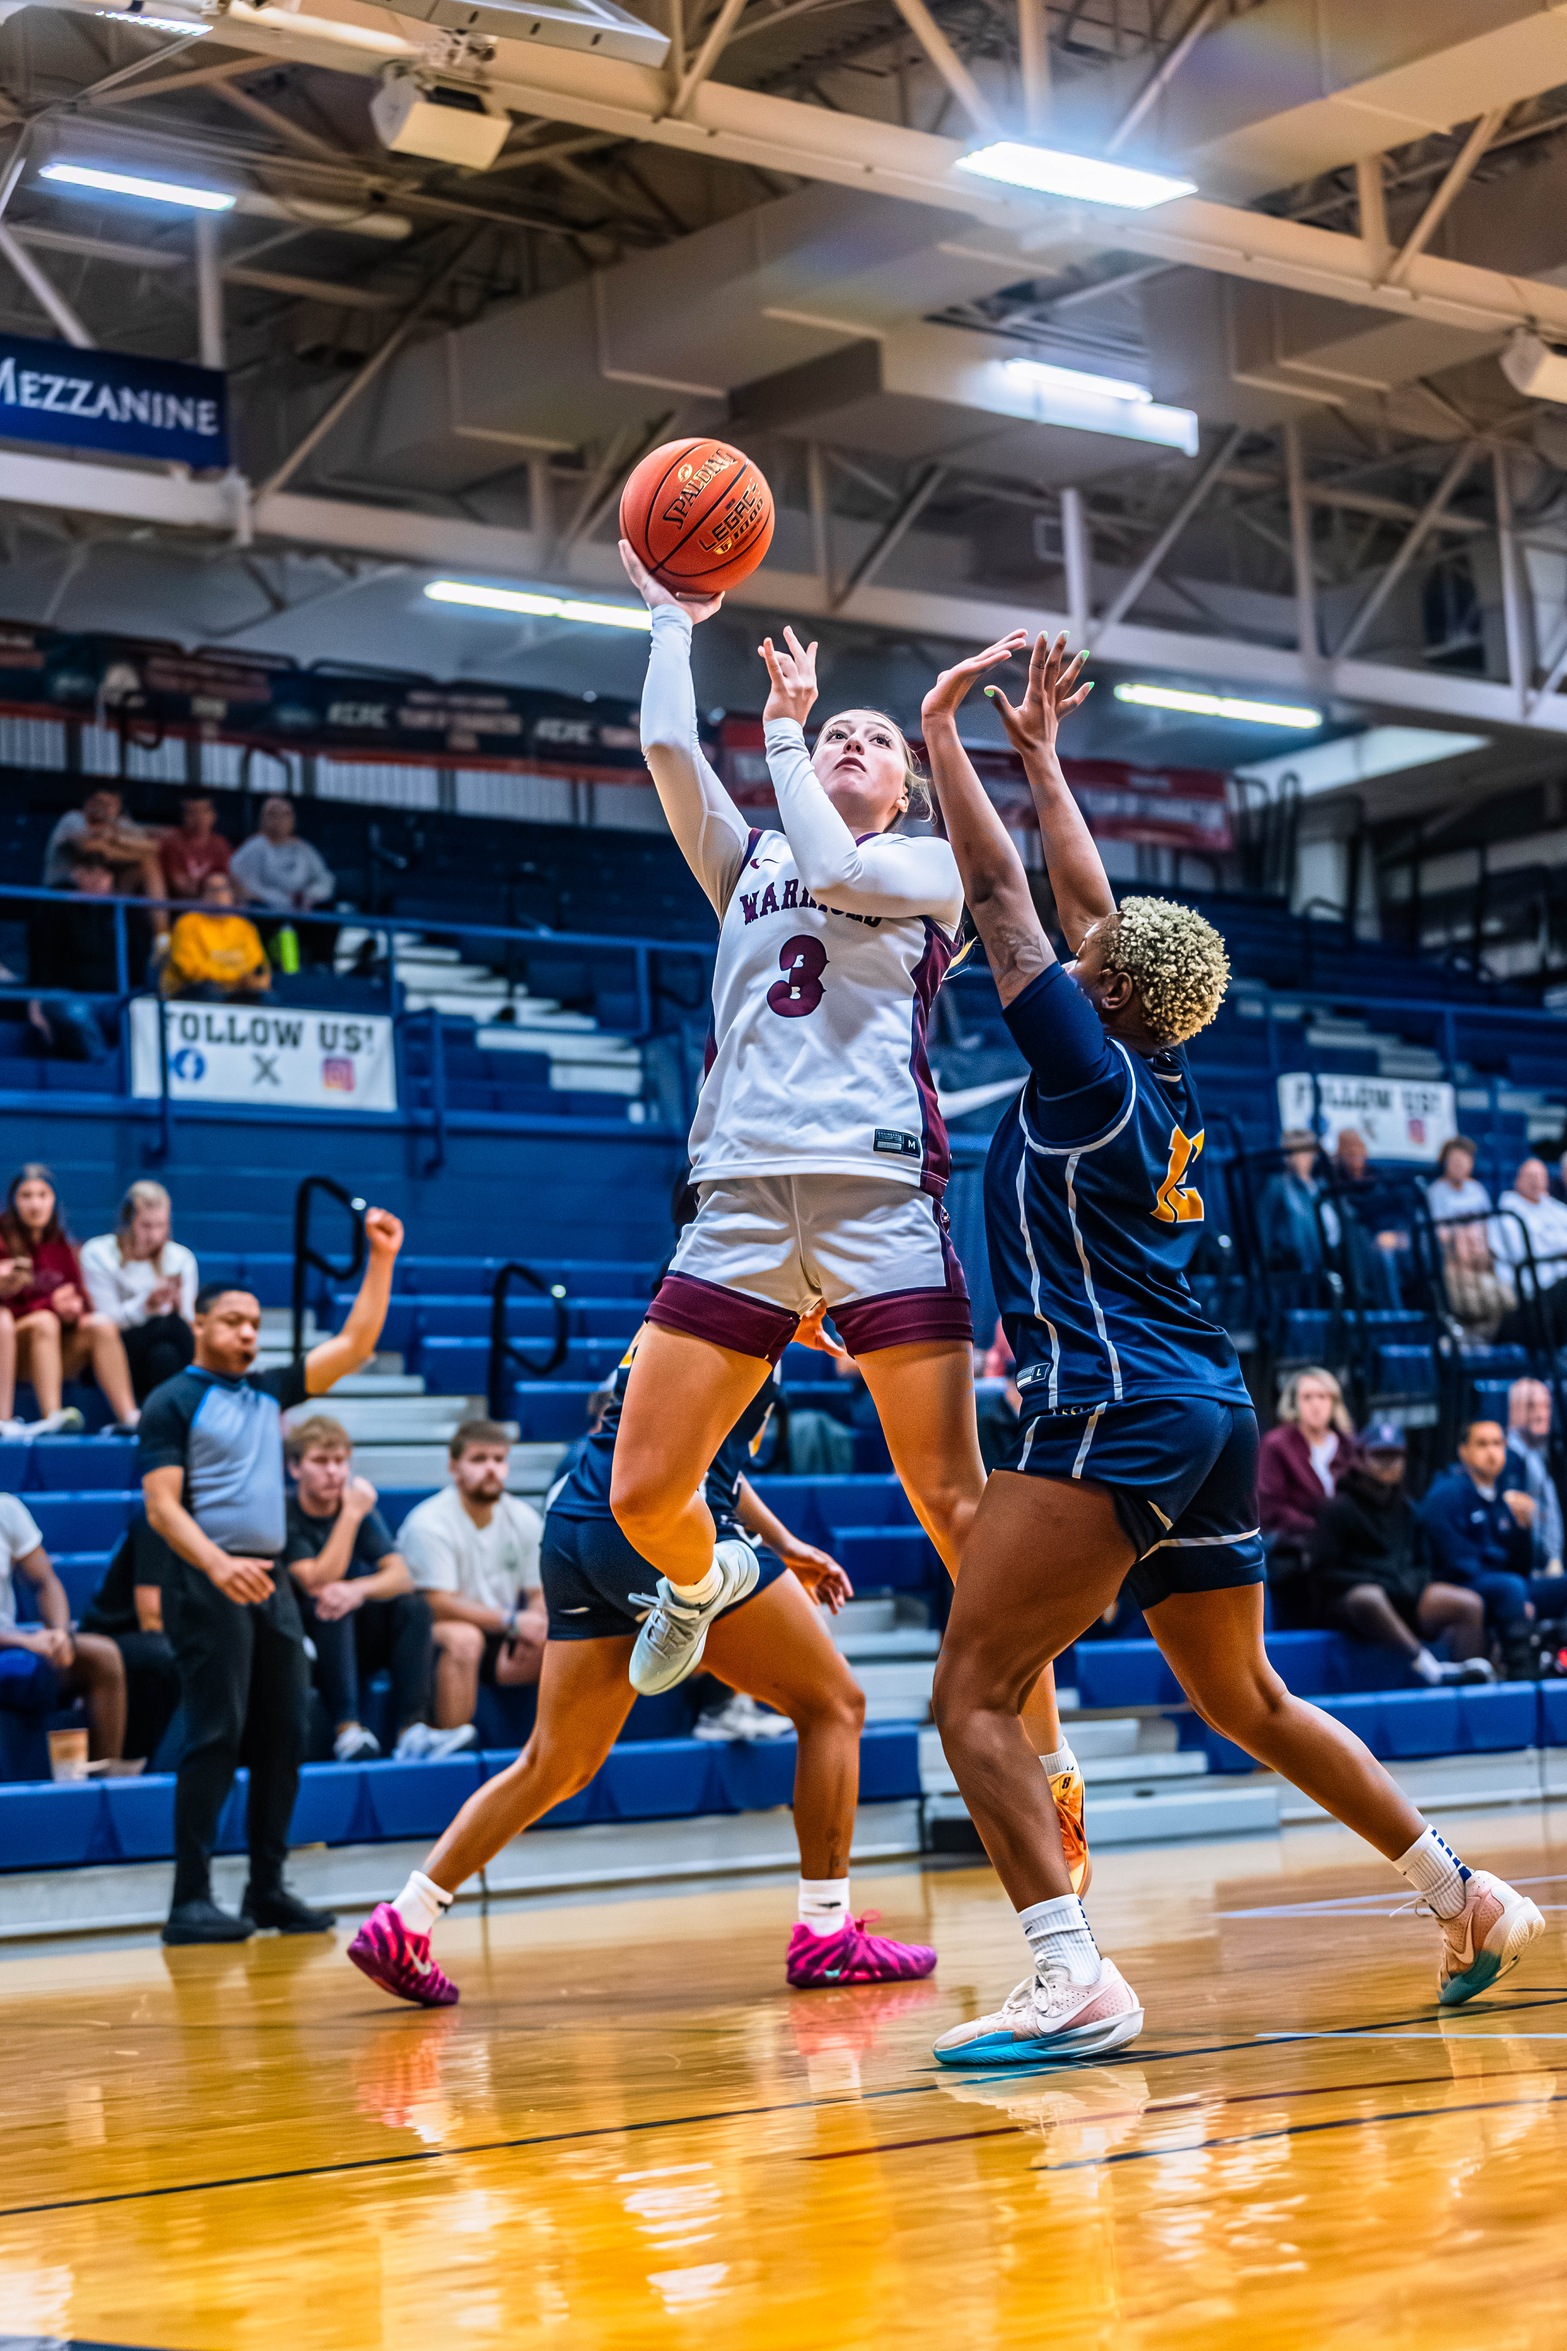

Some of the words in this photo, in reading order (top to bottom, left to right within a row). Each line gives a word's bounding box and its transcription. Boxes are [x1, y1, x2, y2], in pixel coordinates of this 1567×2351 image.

[662, 448, 738, 531] SPALDING
[732, 496, 764, 540] 1000
[766, 934, 830, 1018] 3
[167, 1012, 303, 1049] OLLOW
[319, 1021, 374, 1056] US!
[908, 1139, 916, 1150] M
[1036, 1368, 1042, 1376] L
